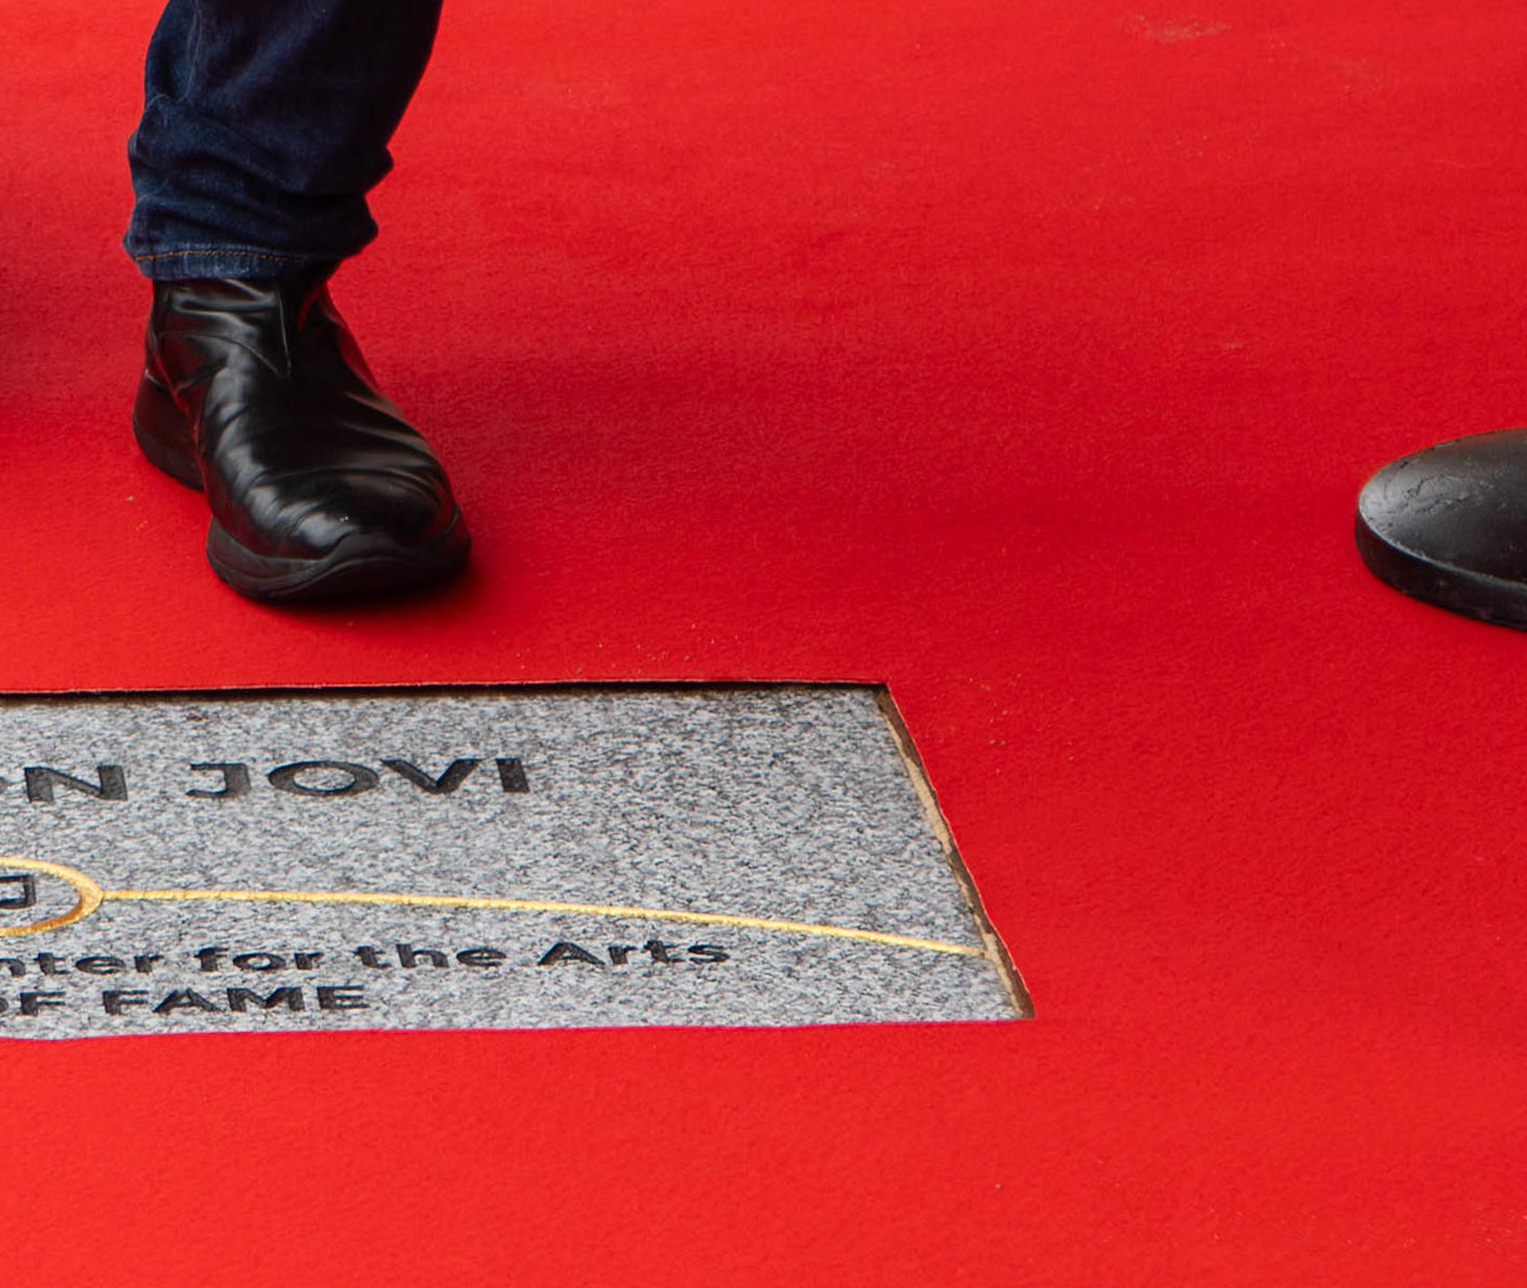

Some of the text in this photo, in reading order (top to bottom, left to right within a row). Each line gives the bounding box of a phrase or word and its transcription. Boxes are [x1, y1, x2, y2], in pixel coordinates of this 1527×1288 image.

[186, 757, 530, 798] JOVI
[194, 946, 323, 973] for
[355, 943, 507, 970] the
[537, 939, 731, 967] Arts
[102, 985, 370, 1015] FAME
